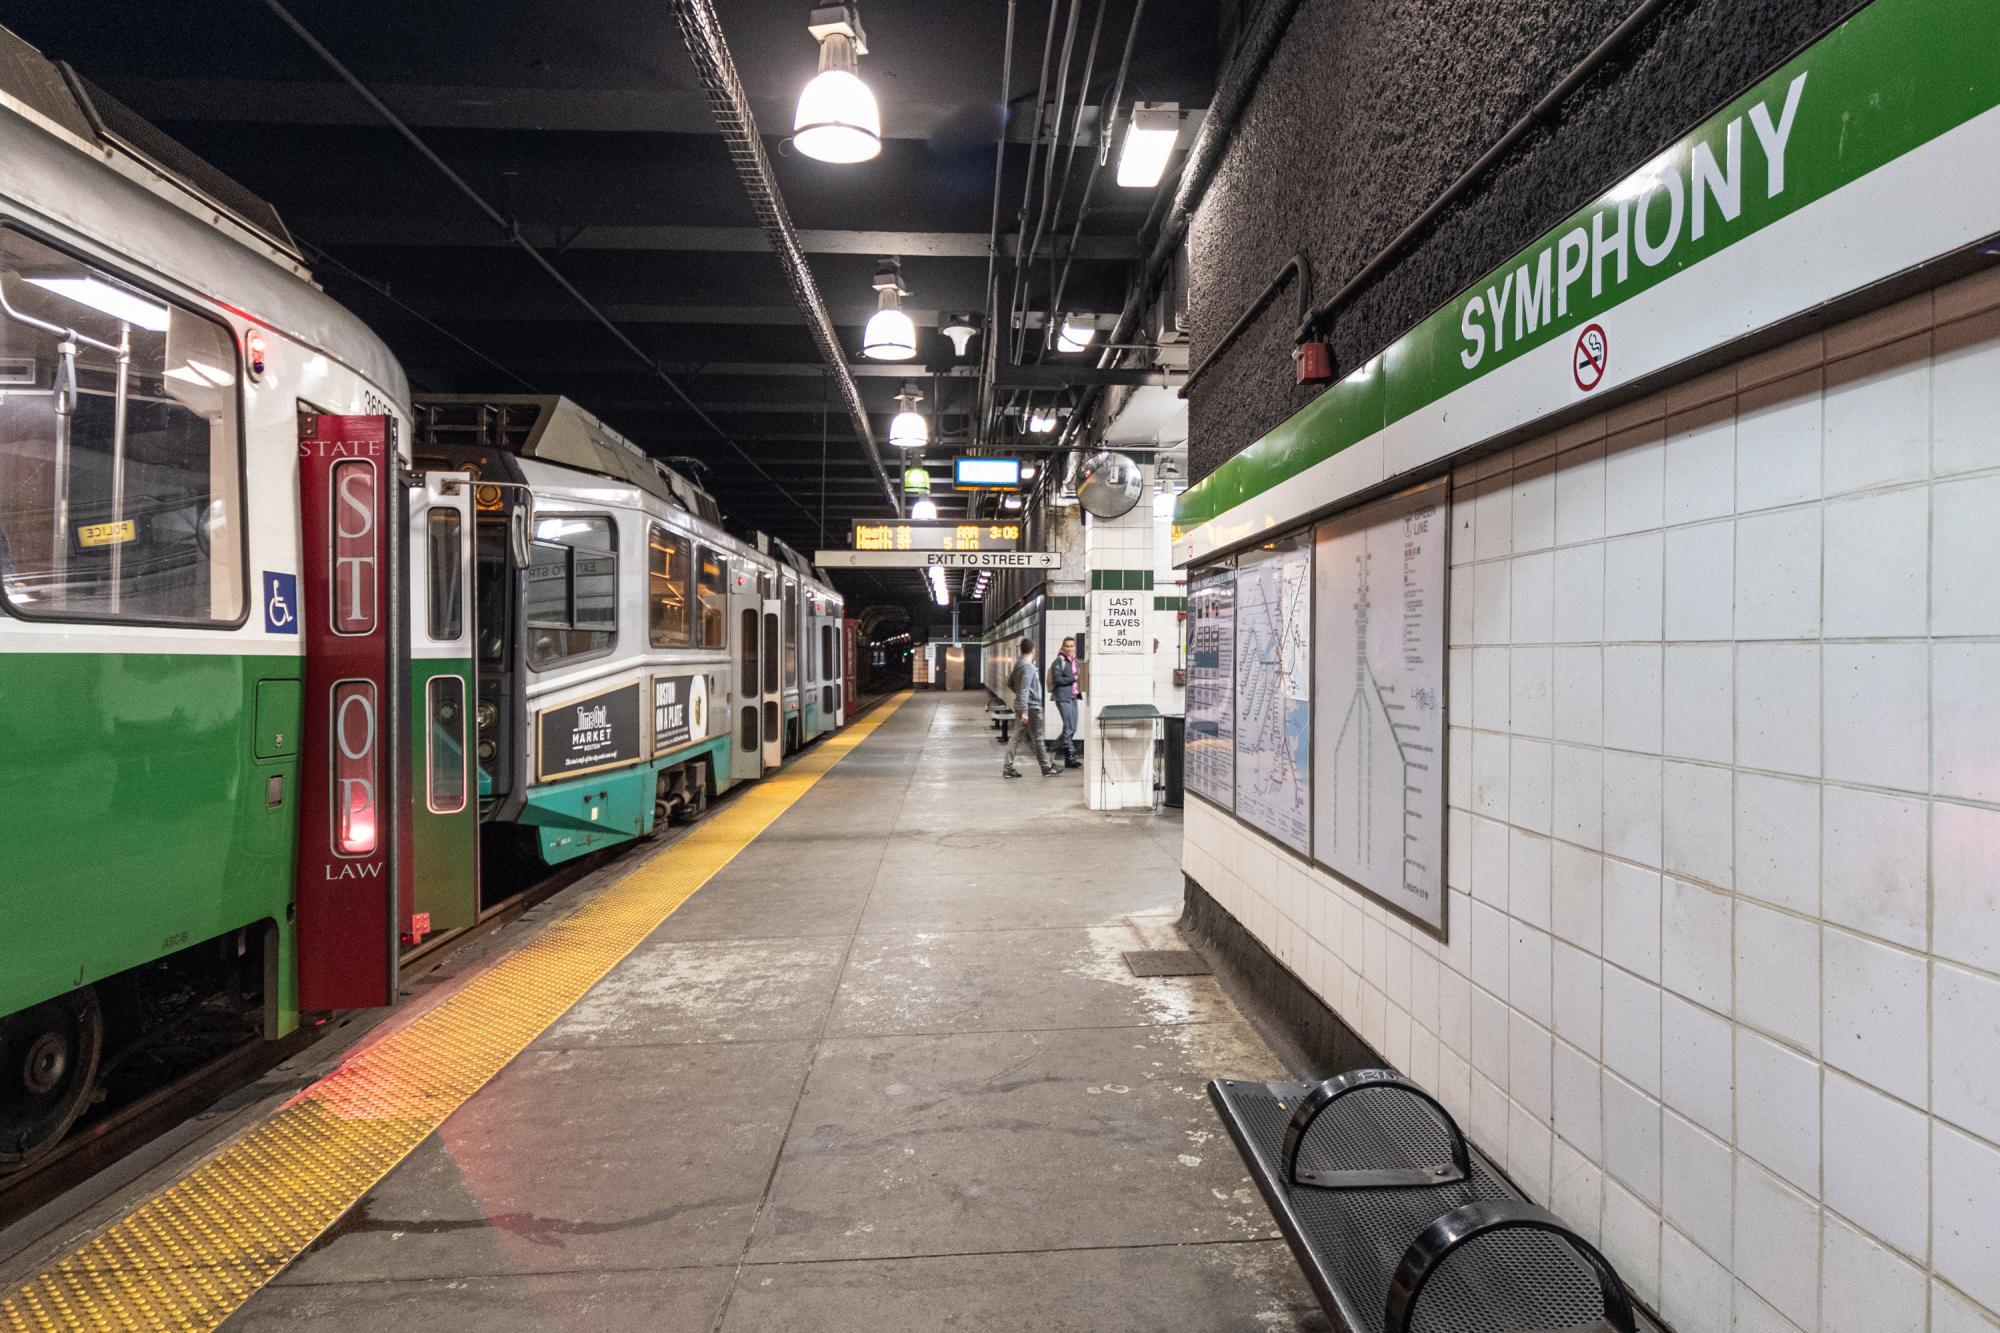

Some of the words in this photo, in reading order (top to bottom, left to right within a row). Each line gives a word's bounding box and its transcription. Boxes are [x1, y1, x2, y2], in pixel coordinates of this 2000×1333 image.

[1460, 71, 1808, 370] SYMPHONY
[299, 440, 381, 457] STATE
[989, 525, 1019, 539] 3:06
[1414, 520, 1429, 535] LINE
[943, 537, 953, 550] 5
[927, 553, 956, 565] EXIT
[960, 554, 978, 565] TO
[982, 554, 1033, 566] STREET
[1109, 597, 1134, 606] LAST
[1107, 608, 1137, 616] TRAIN
[1103, 619, 1140, 627] LEAVES
[1102, 638, 1141, 647] 12:50am
[336, 473, 375, 842] STOP
[572, 729, 611, 745] MARKET
[325, 862, 383, 880] LAW
